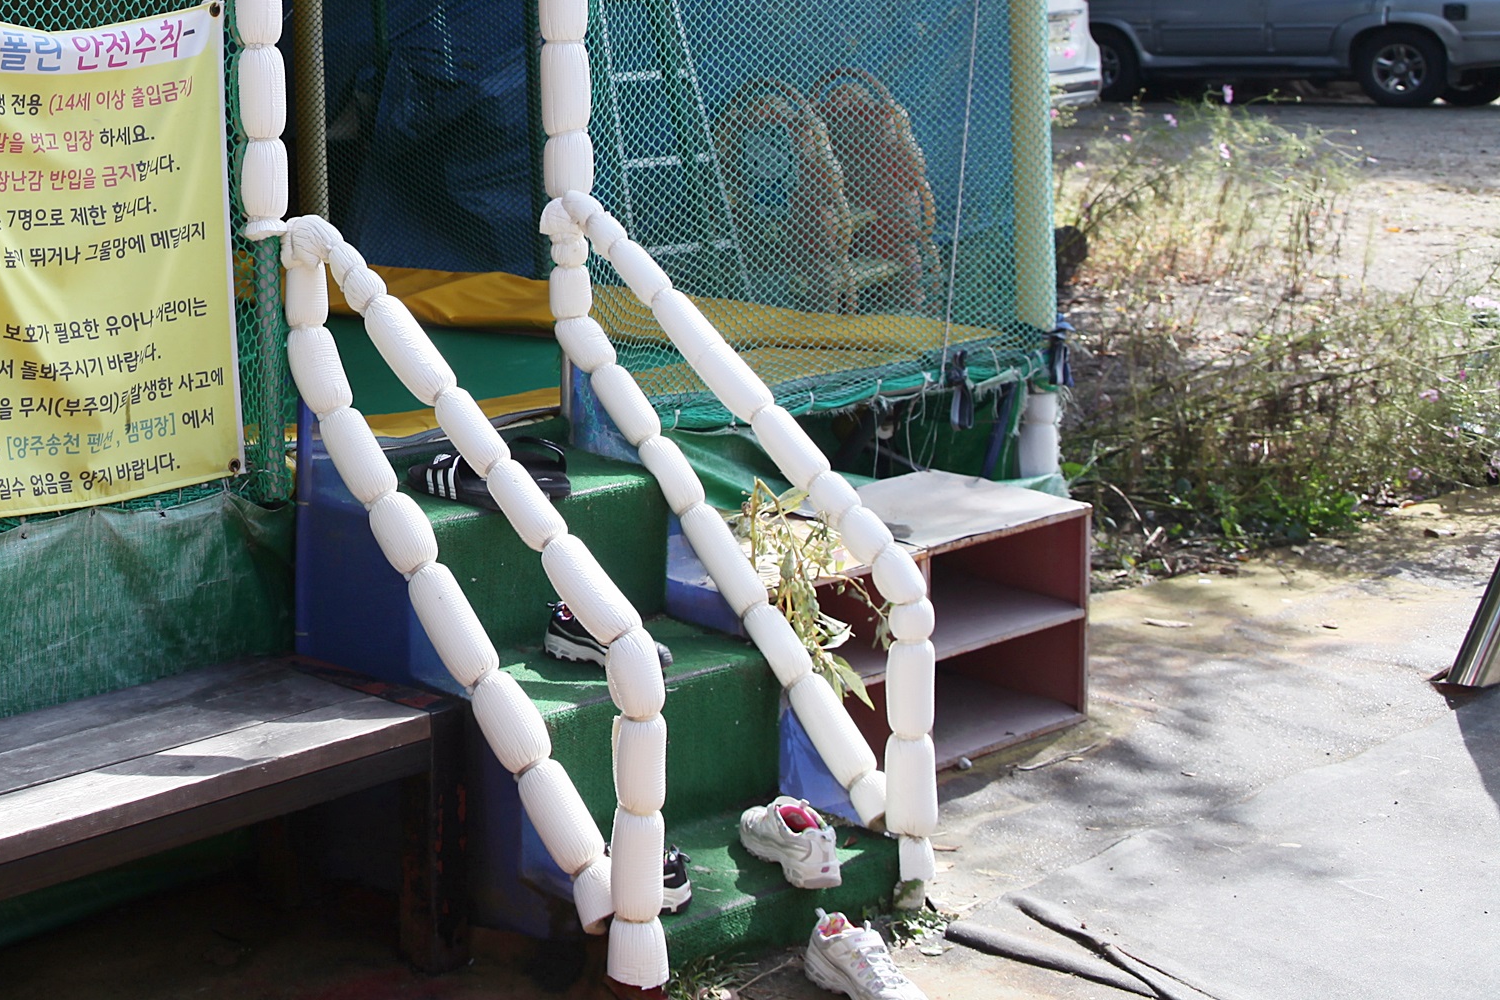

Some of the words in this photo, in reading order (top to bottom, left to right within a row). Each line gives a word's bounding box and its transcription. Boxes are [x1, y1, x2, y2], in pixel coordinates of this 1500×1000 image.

[11, 94, 43, 116] 전용
[49, 91, 92, 116] (14세
[96, 89, 126, 111] 이상
[30, 132, 60, 154] 벗고
[63, 130, 95, 153] 입장
[99, 124, 156, 148] 하세요.
[49, 167, 97, 191] 반입을
[6, 208, 65, 231] 7명으로
[70, 205, 107, 227] 제한
[112, 195, 157, 223] 합니다.
[4, 246, 26, 269] 높이
[29, 245, 81, 268] 뛰거나
[85, 234, 146, 262] 그물망에
[150, 221, 206, 249] 메달리지
[3, 323, 50, 344] 보호가
[53, 317, 100, 344] 필요한
[20, 356, 104, 382] 돌봐주시기
[106, 342, 162, 373] 바랍니다.
[178, 366, 225, 393] 사고에
[181, 406, 216, 430] 에서
[30, 470, 74, 497] 없음을
[79, 466, 114, 491] 양지
[116, 452, 181, 482] 바랍니다.
